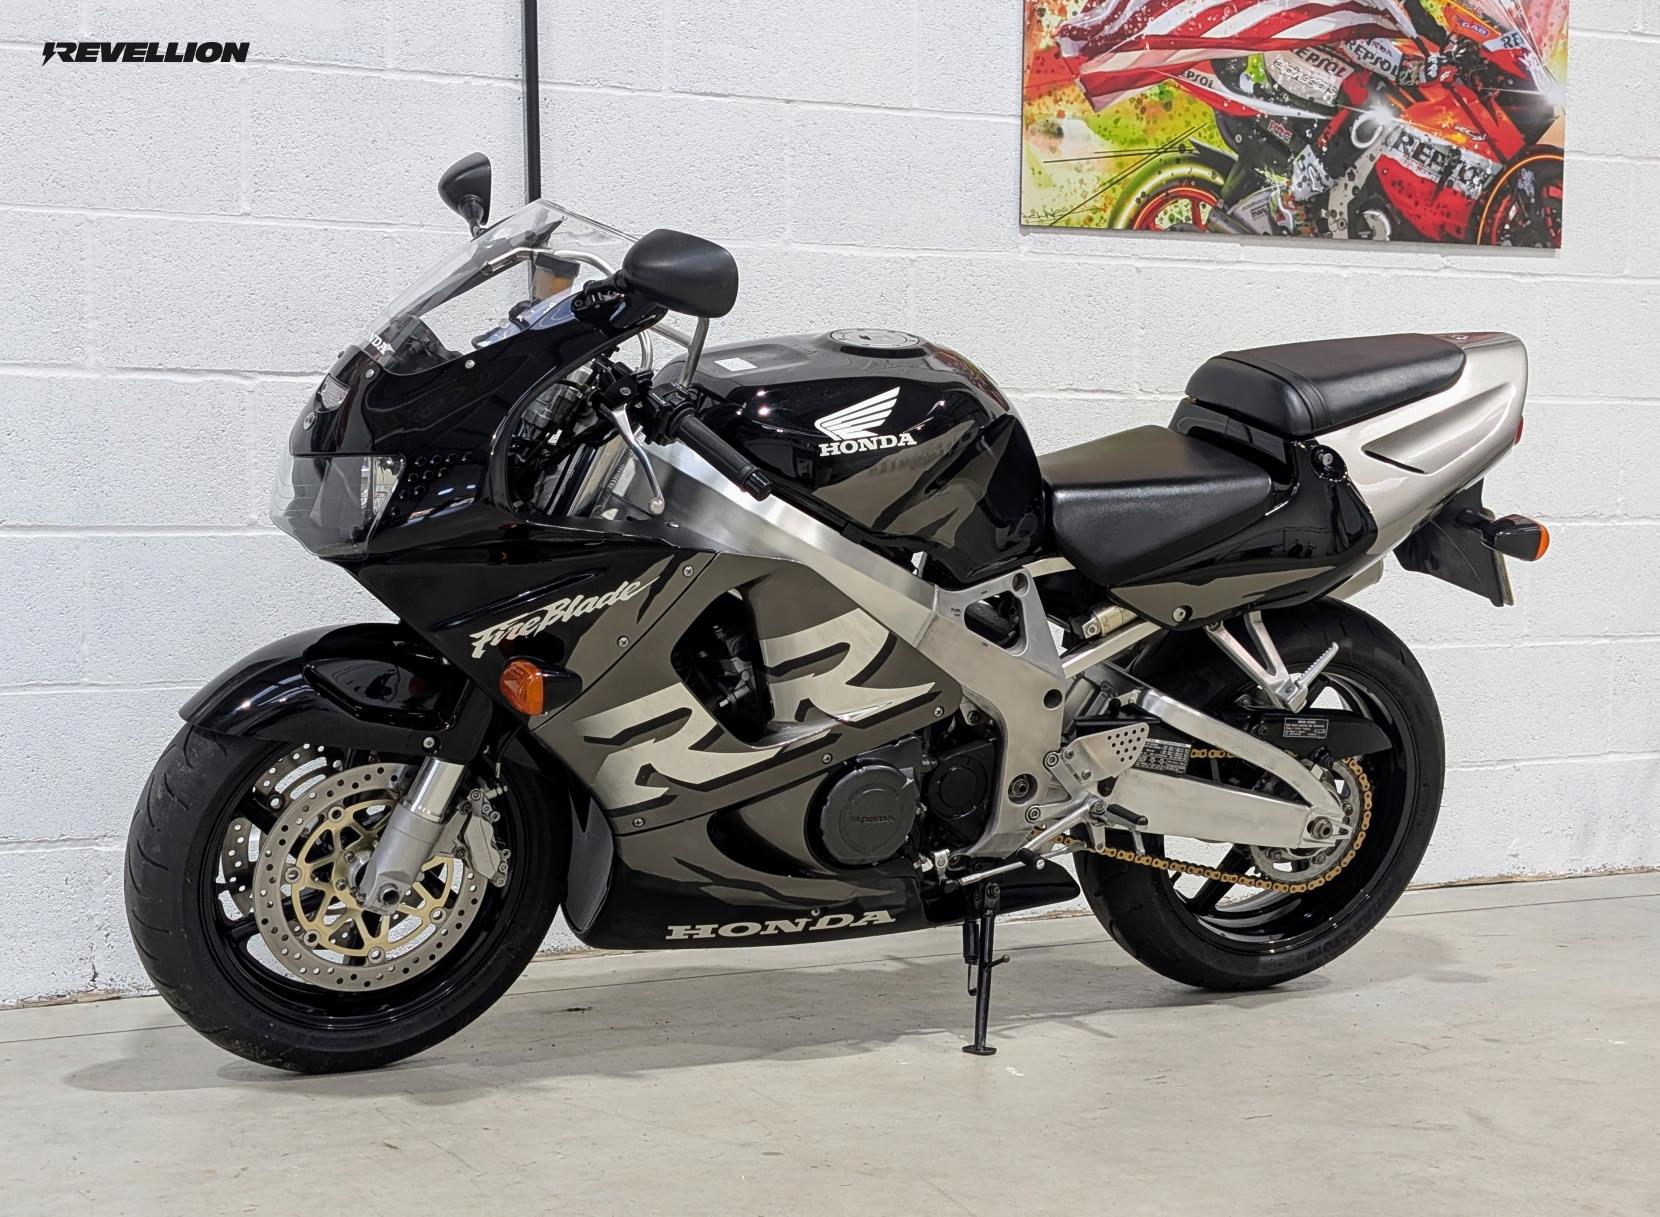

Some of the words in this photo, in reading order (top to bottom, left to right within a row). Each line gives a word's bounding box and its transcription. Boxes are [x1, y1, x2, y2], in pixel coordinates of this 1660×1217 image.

[1393, 129, 1490, 189] REPO
[818, 432, 918, 457] HONDA
[469, 575, 661, 659] FireBlade
[665, 909, 897, 940] HONDA
